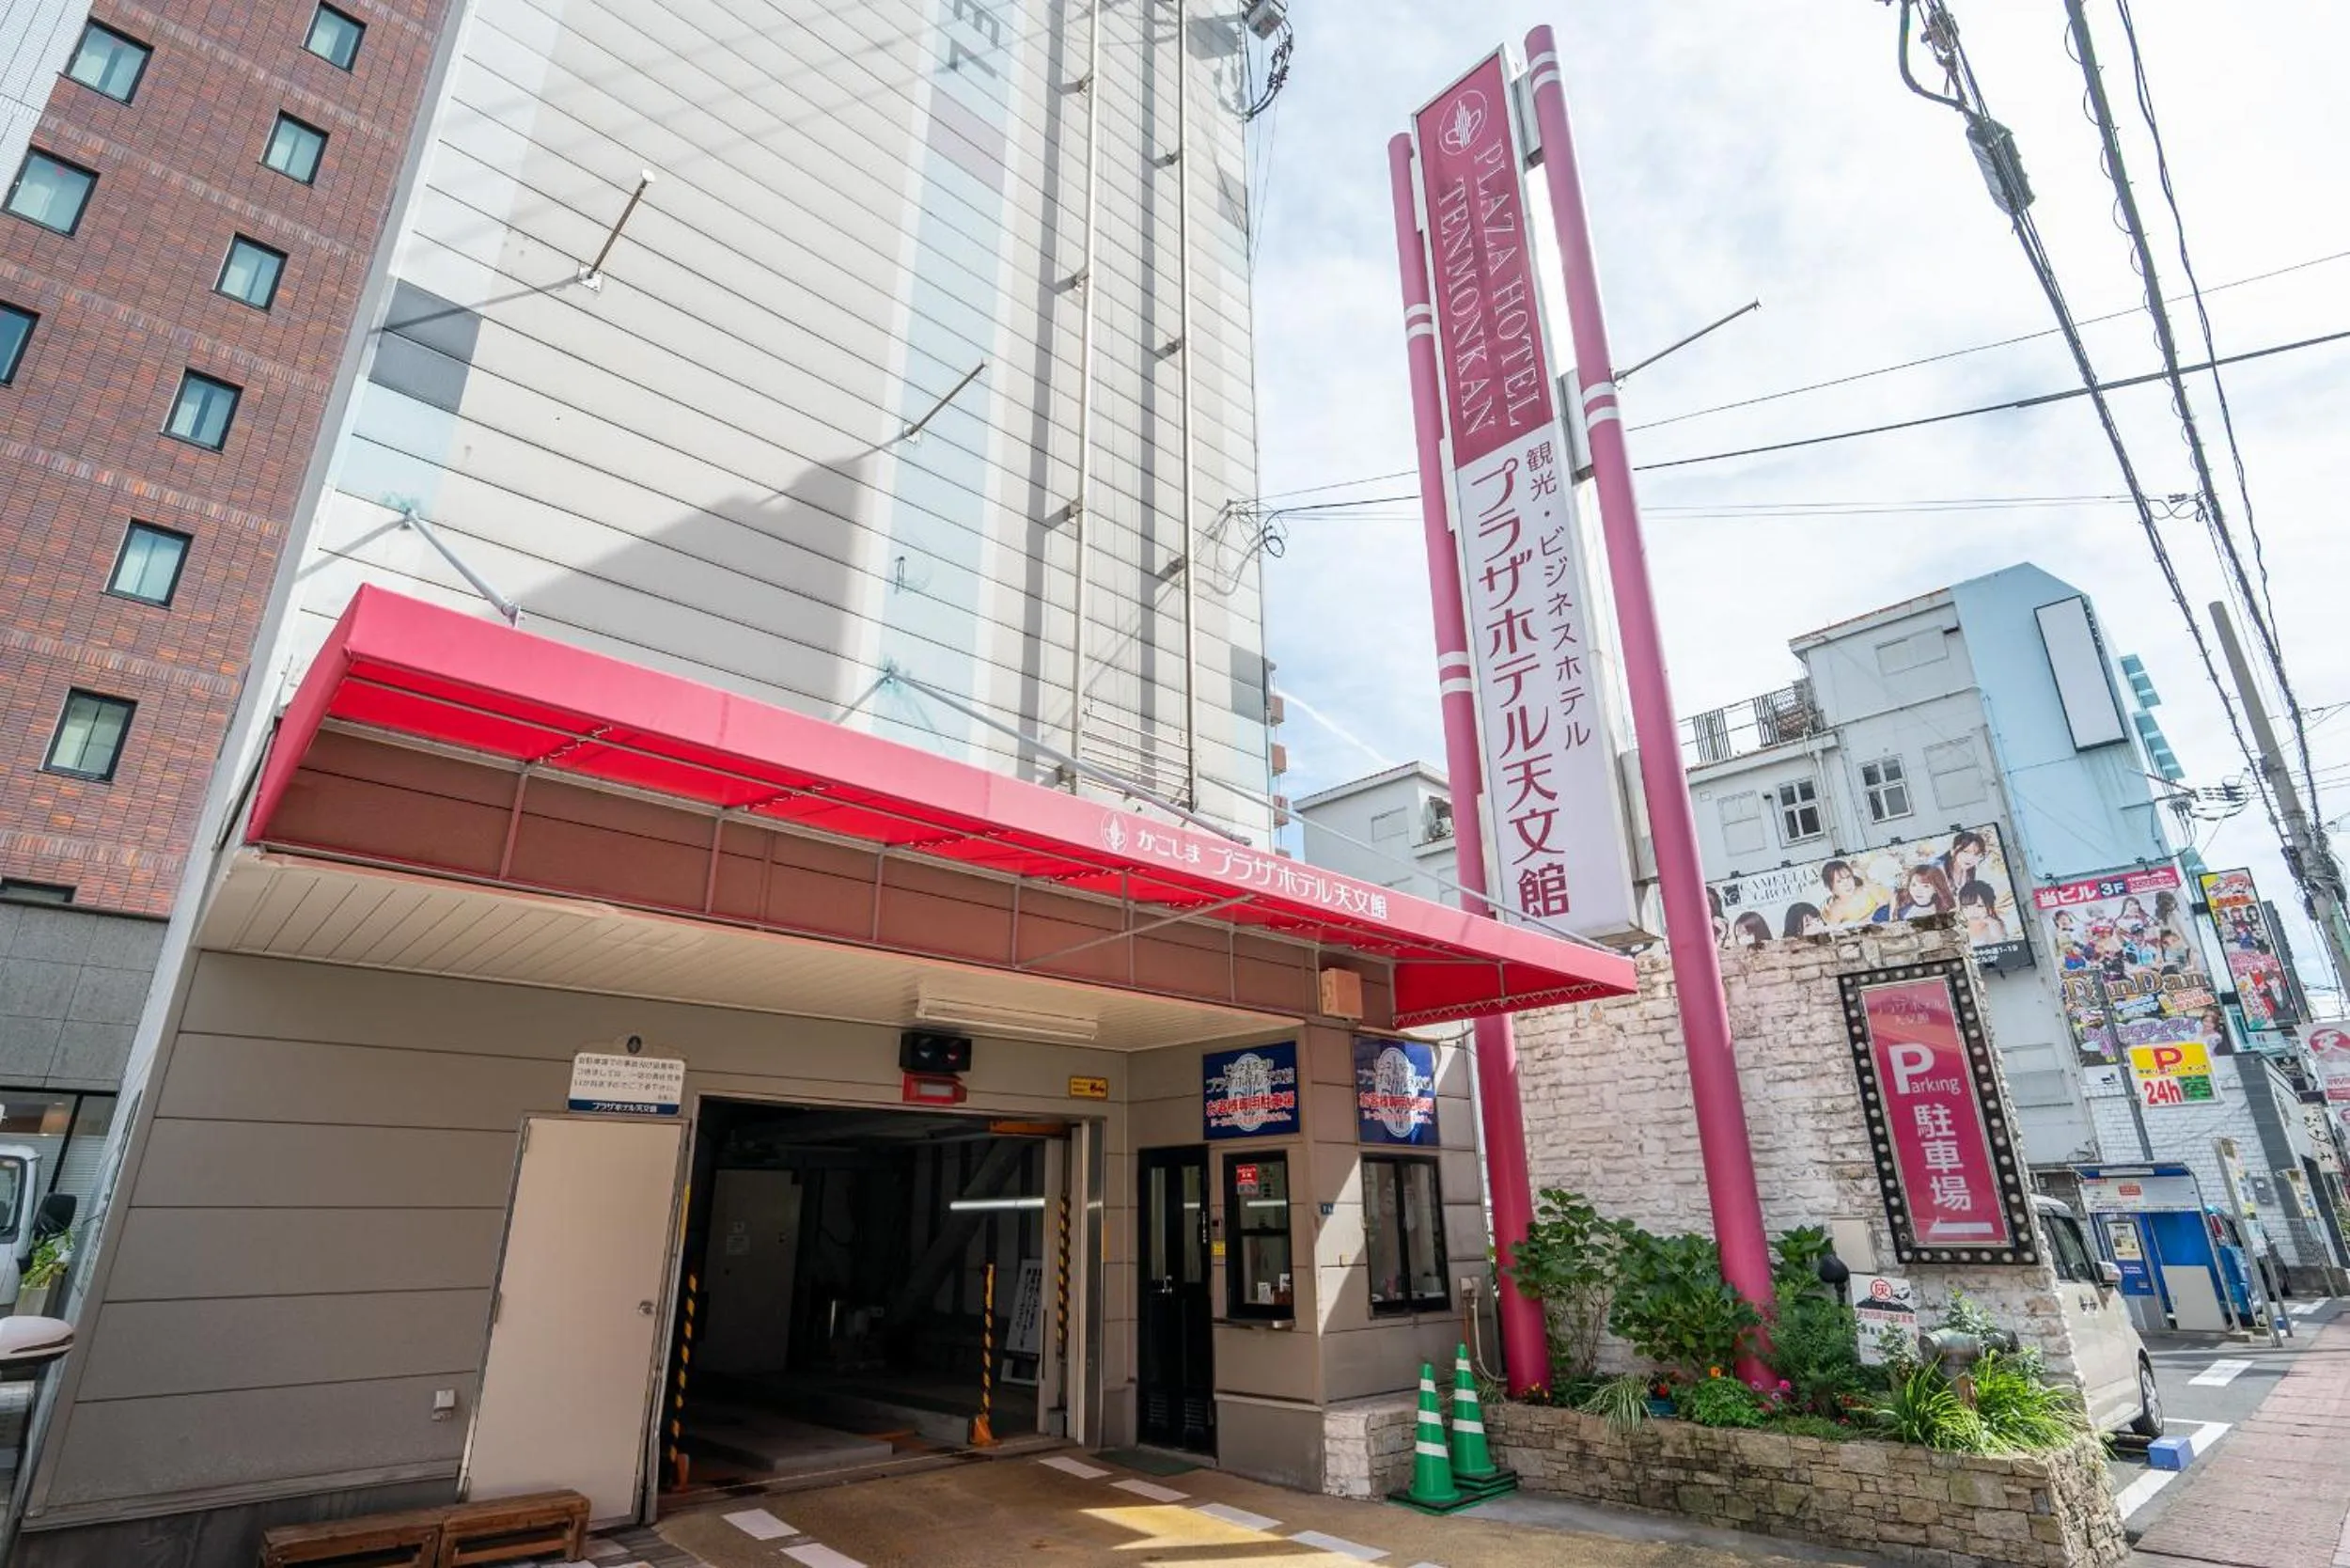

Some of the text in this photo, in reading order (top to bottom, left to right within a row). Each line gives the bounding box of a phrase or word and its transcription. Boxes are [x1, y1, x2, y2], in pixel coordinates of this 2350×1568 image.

[1437, 175, 1496, 437] TENMONKAN
[1474, 136, 1542, 428] PLAZA HOTEL
[1525, 440, 1591, 751] 観光・ビジネスホテル
[1471, 457, 1570, 923] プラザホテル天文館
[1210, 846, 1387, 920] プラザホテル天文館
[1888, 1043, 1962, 1095] Parking
[2143, 1079, 2183, 1105] 24h
[2153, 1047, 2183, 1071] P
[1913, 1103, 1972, 1211] 駐車場
